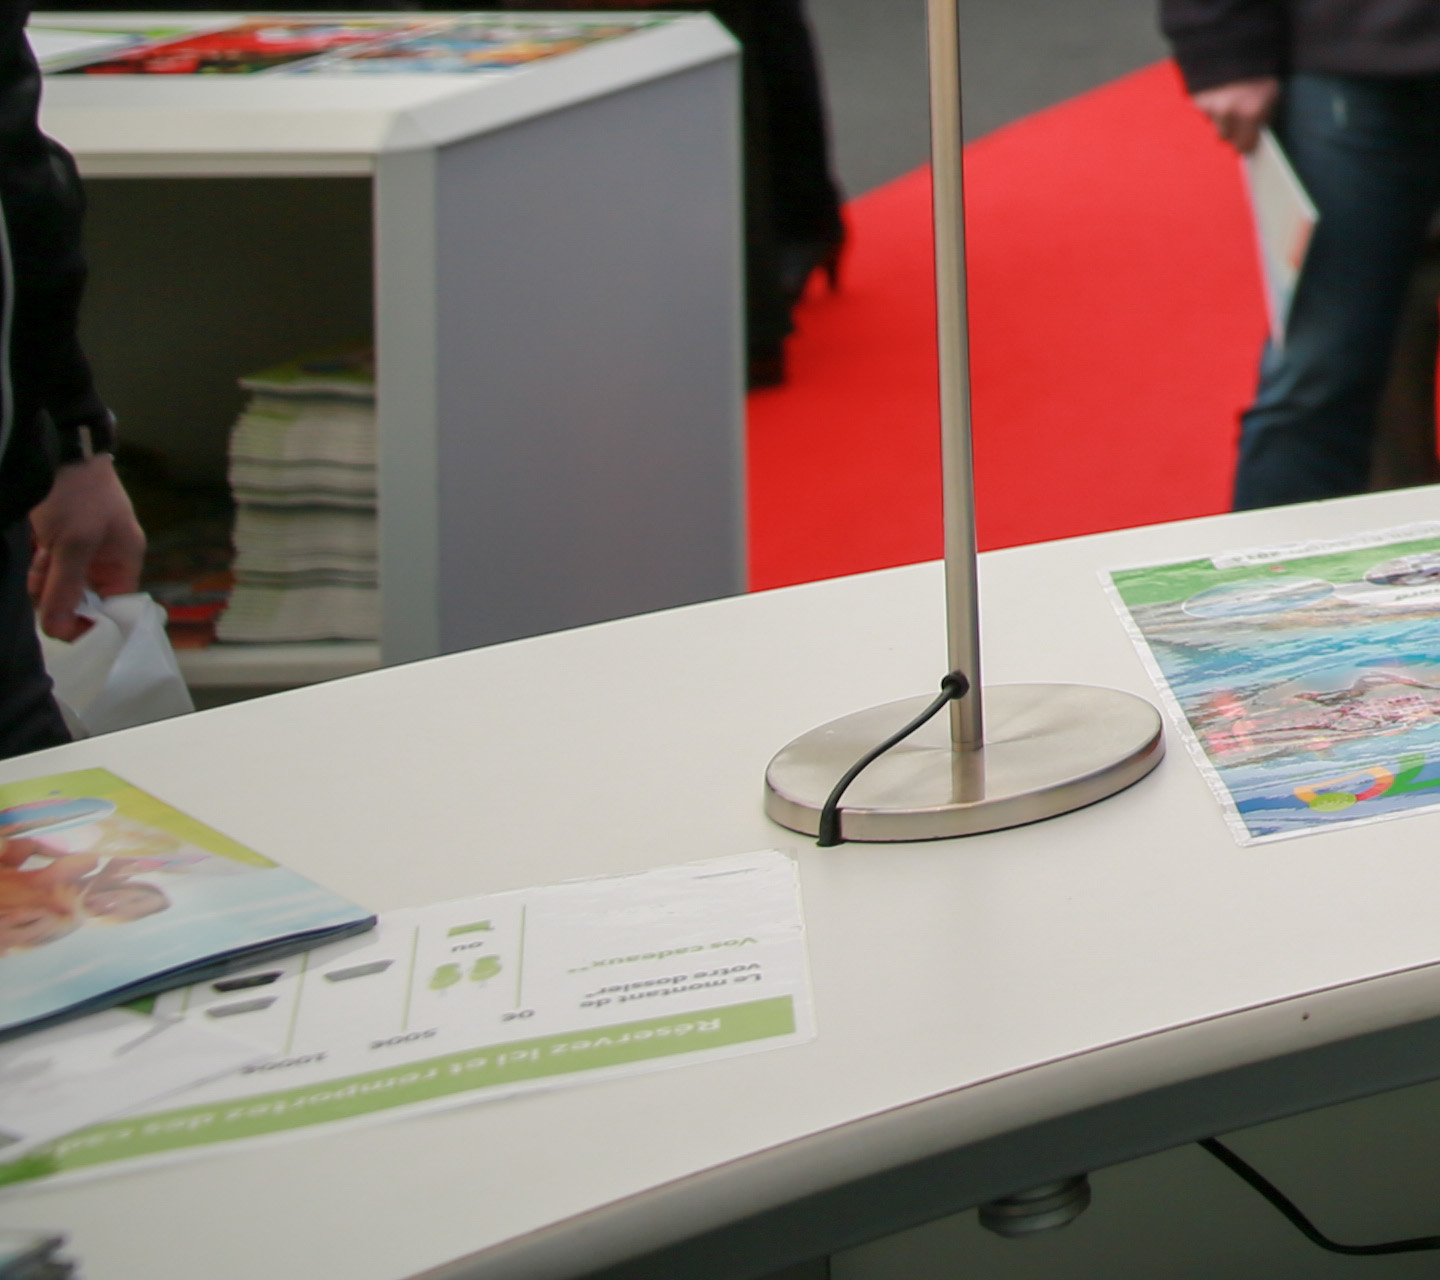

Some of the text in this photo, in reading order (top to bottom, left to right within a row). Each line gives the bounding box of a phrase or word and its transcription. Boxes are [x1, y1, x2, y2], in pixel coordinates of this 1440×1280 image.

[450, 941, 484, 953] ou
[711, 937, 758, 948] Vos
[693, 962, 761, 978] votre
[579, 972, 762, 1008] Le montant de
[501, 1008, 535, 1022] 0€
[368, 1028, 438, 1050] 500€
[552, 1018, 721, 1055] Réservez
[449, 1057, 488, 1076] et
[496, 1046, 541, 1067] ici
[225, 1067, 439, 1122] remportez
